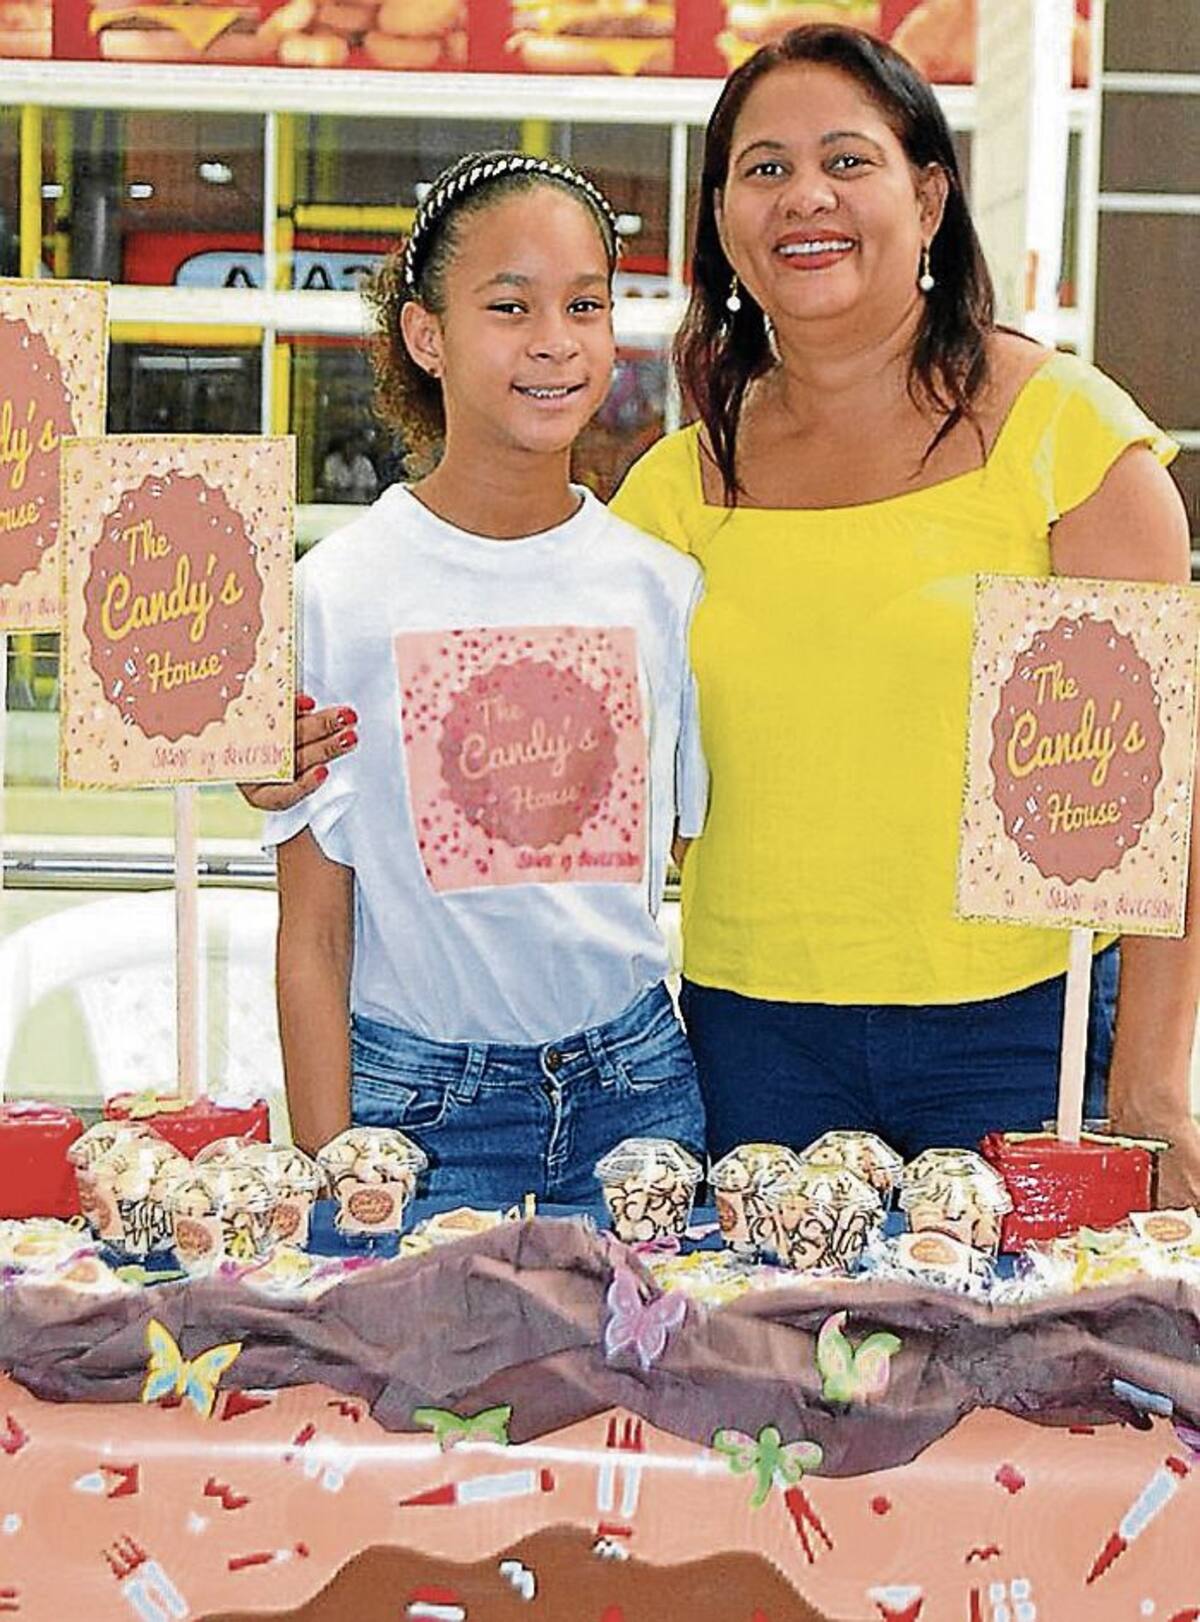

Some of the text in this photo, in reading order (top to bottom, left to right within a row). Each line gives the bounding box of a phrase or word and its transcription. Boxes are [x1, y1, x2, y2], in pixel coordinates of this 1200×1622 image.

[122, 519, 171, 567] The
[101, 553, 243, 643] Candy's
[146, 650, 223, 694] House
[1034, 659, 1080, 705] The
[460, 715, 600, 779] Candy's
[1007, 698, 1147, 787] Candy's
[1047, 792, 1122, 835] House
